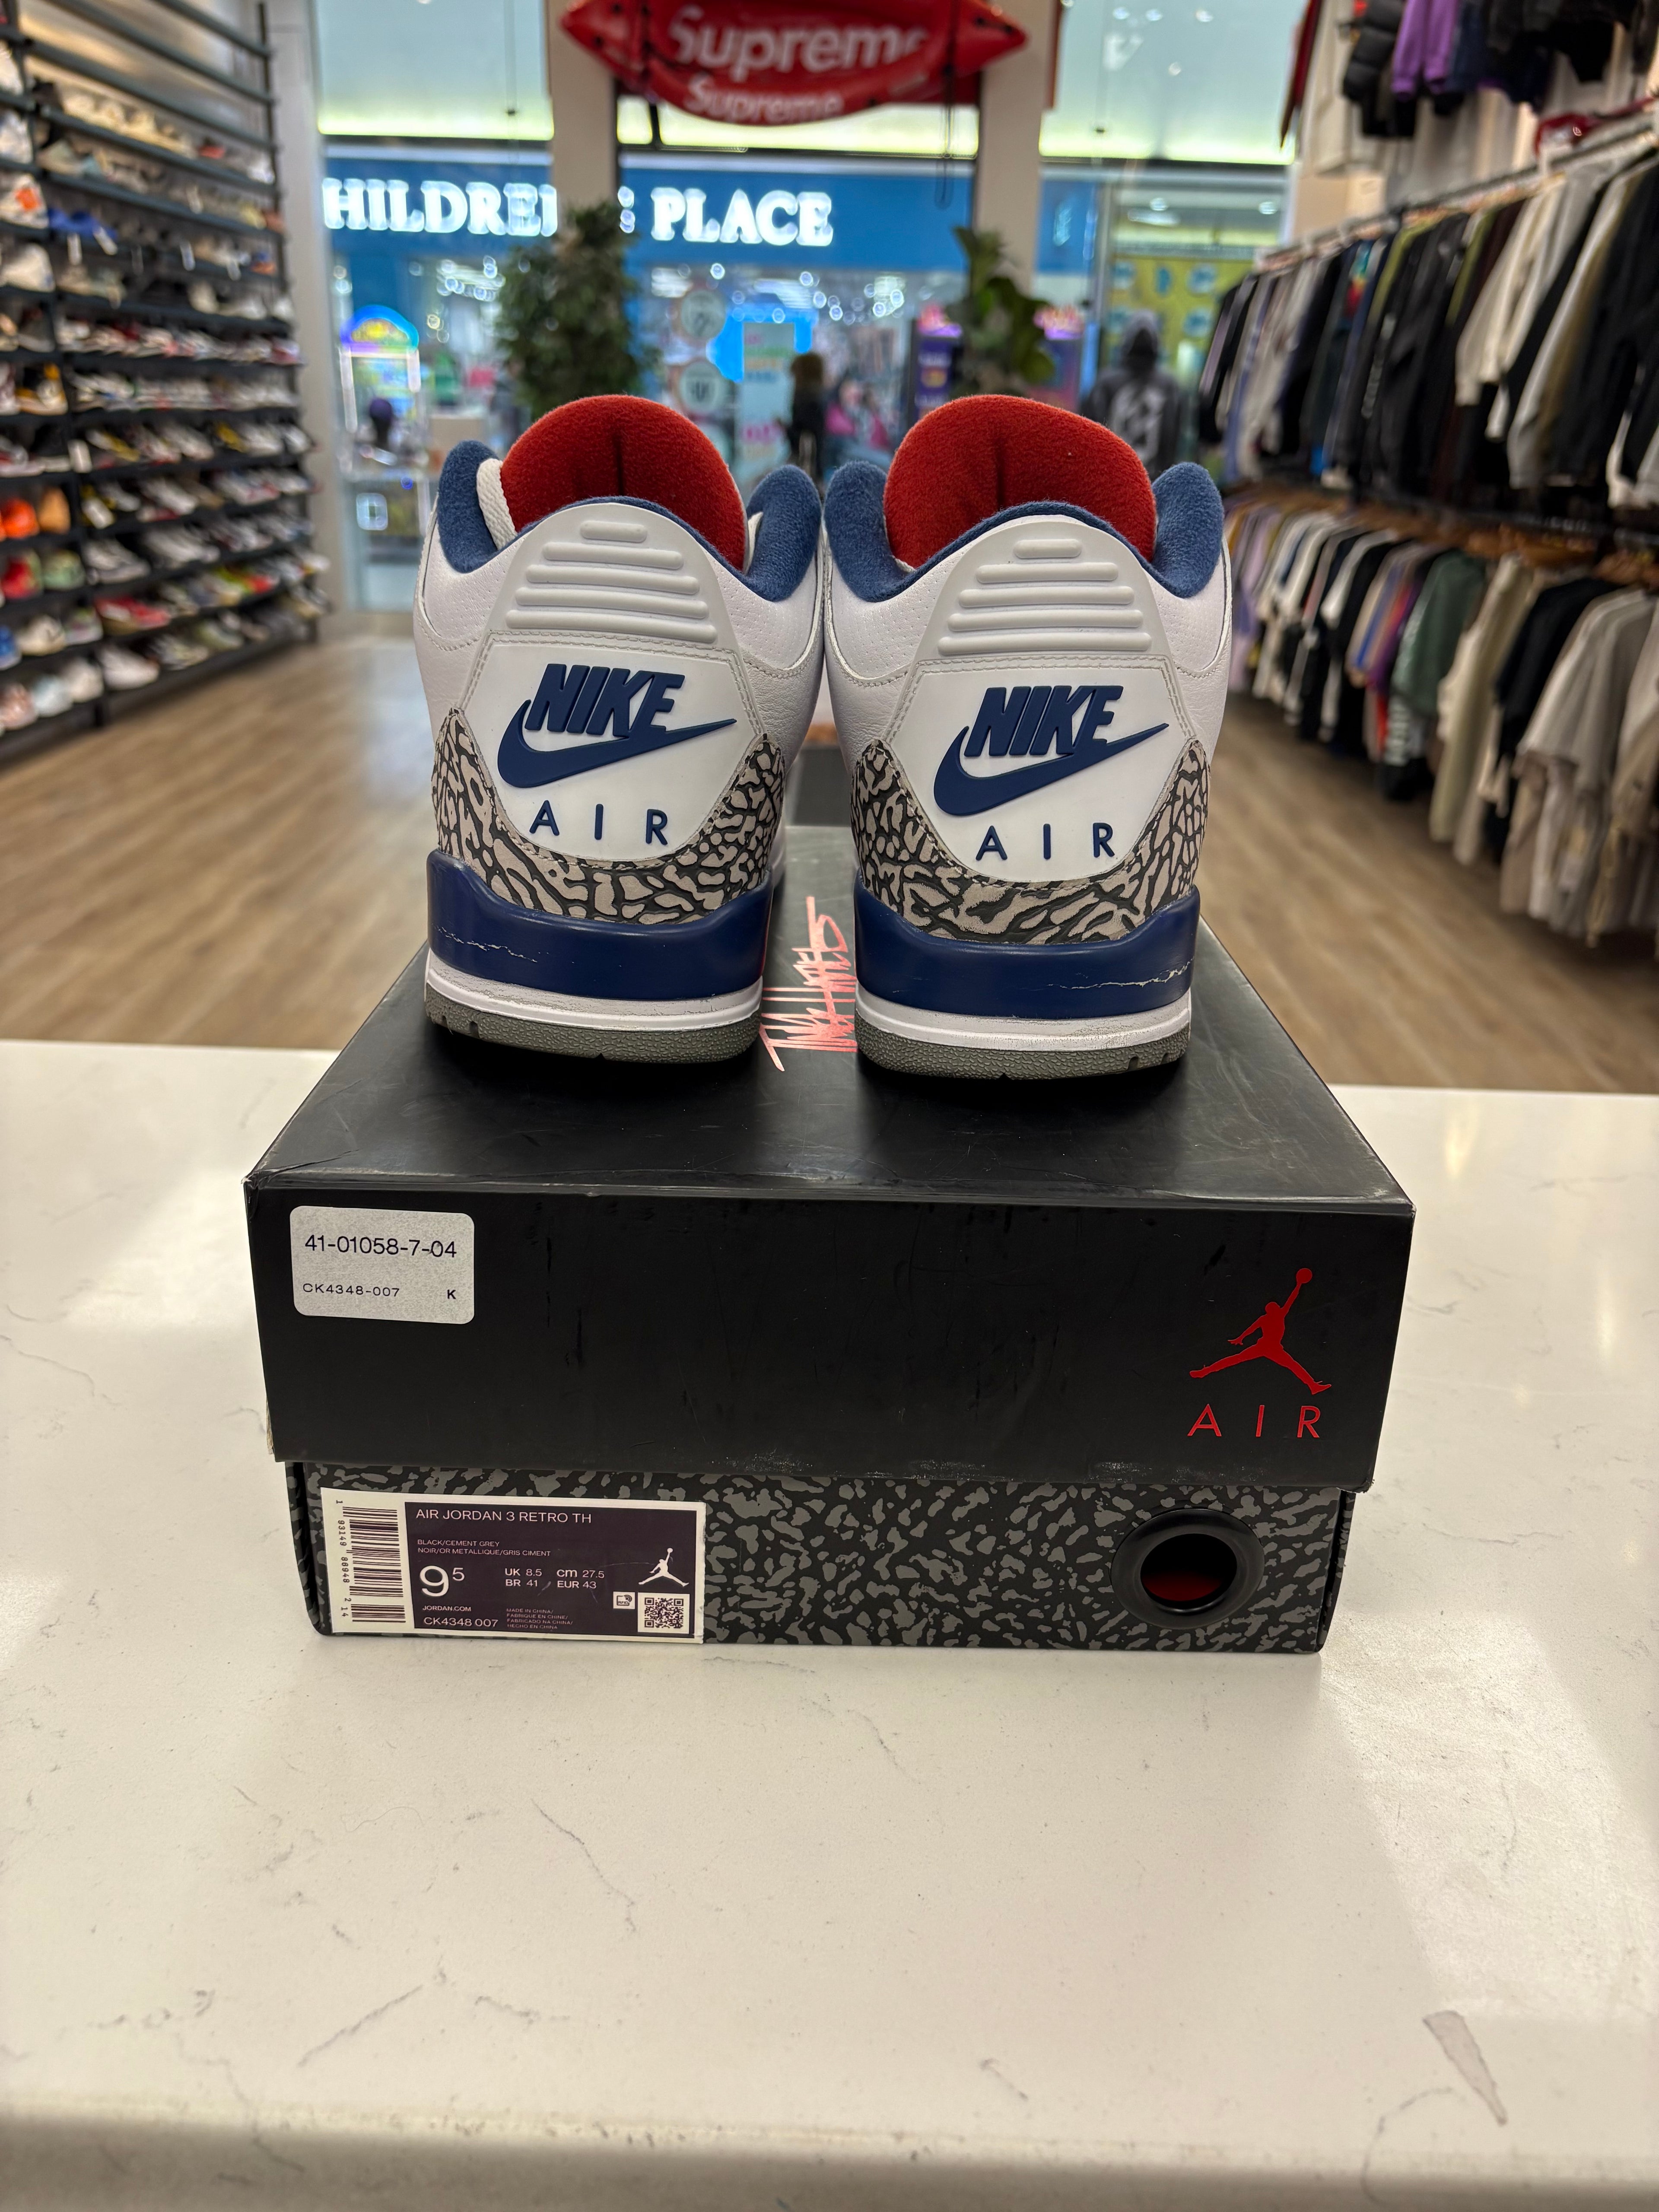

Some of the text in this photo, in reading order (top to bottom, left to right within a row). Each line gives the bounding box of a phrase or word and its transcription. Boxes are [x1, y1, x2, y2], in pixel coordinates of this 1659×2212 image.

[651, 187, 833, 246] PLACE
[524, 663, 685, 737] NIKE
[964, 685, 1123, 756] NIKE
[529, 800, 668, 845] AIR
[976, 822, 1115, 861] AIR
[305, 1234, 457, 1258] 41-01058-7-04
[303, 1283, 456, 1300] CK4348-007 K
[1187, 1403, 1321, 1439] AIR
[416, 1509, 591, 1523] AIR JORDAN 3 RETRO TH
[338, 1520, 347, 1546] 93149
[505, 1568, 604, 1578] UK 8.5 cm 27.5
[557, 1580, 579, 1589] EUR
[582, 1581, 597, 1589] 43
[424, 1617, 498, 1627] CK4348 007
